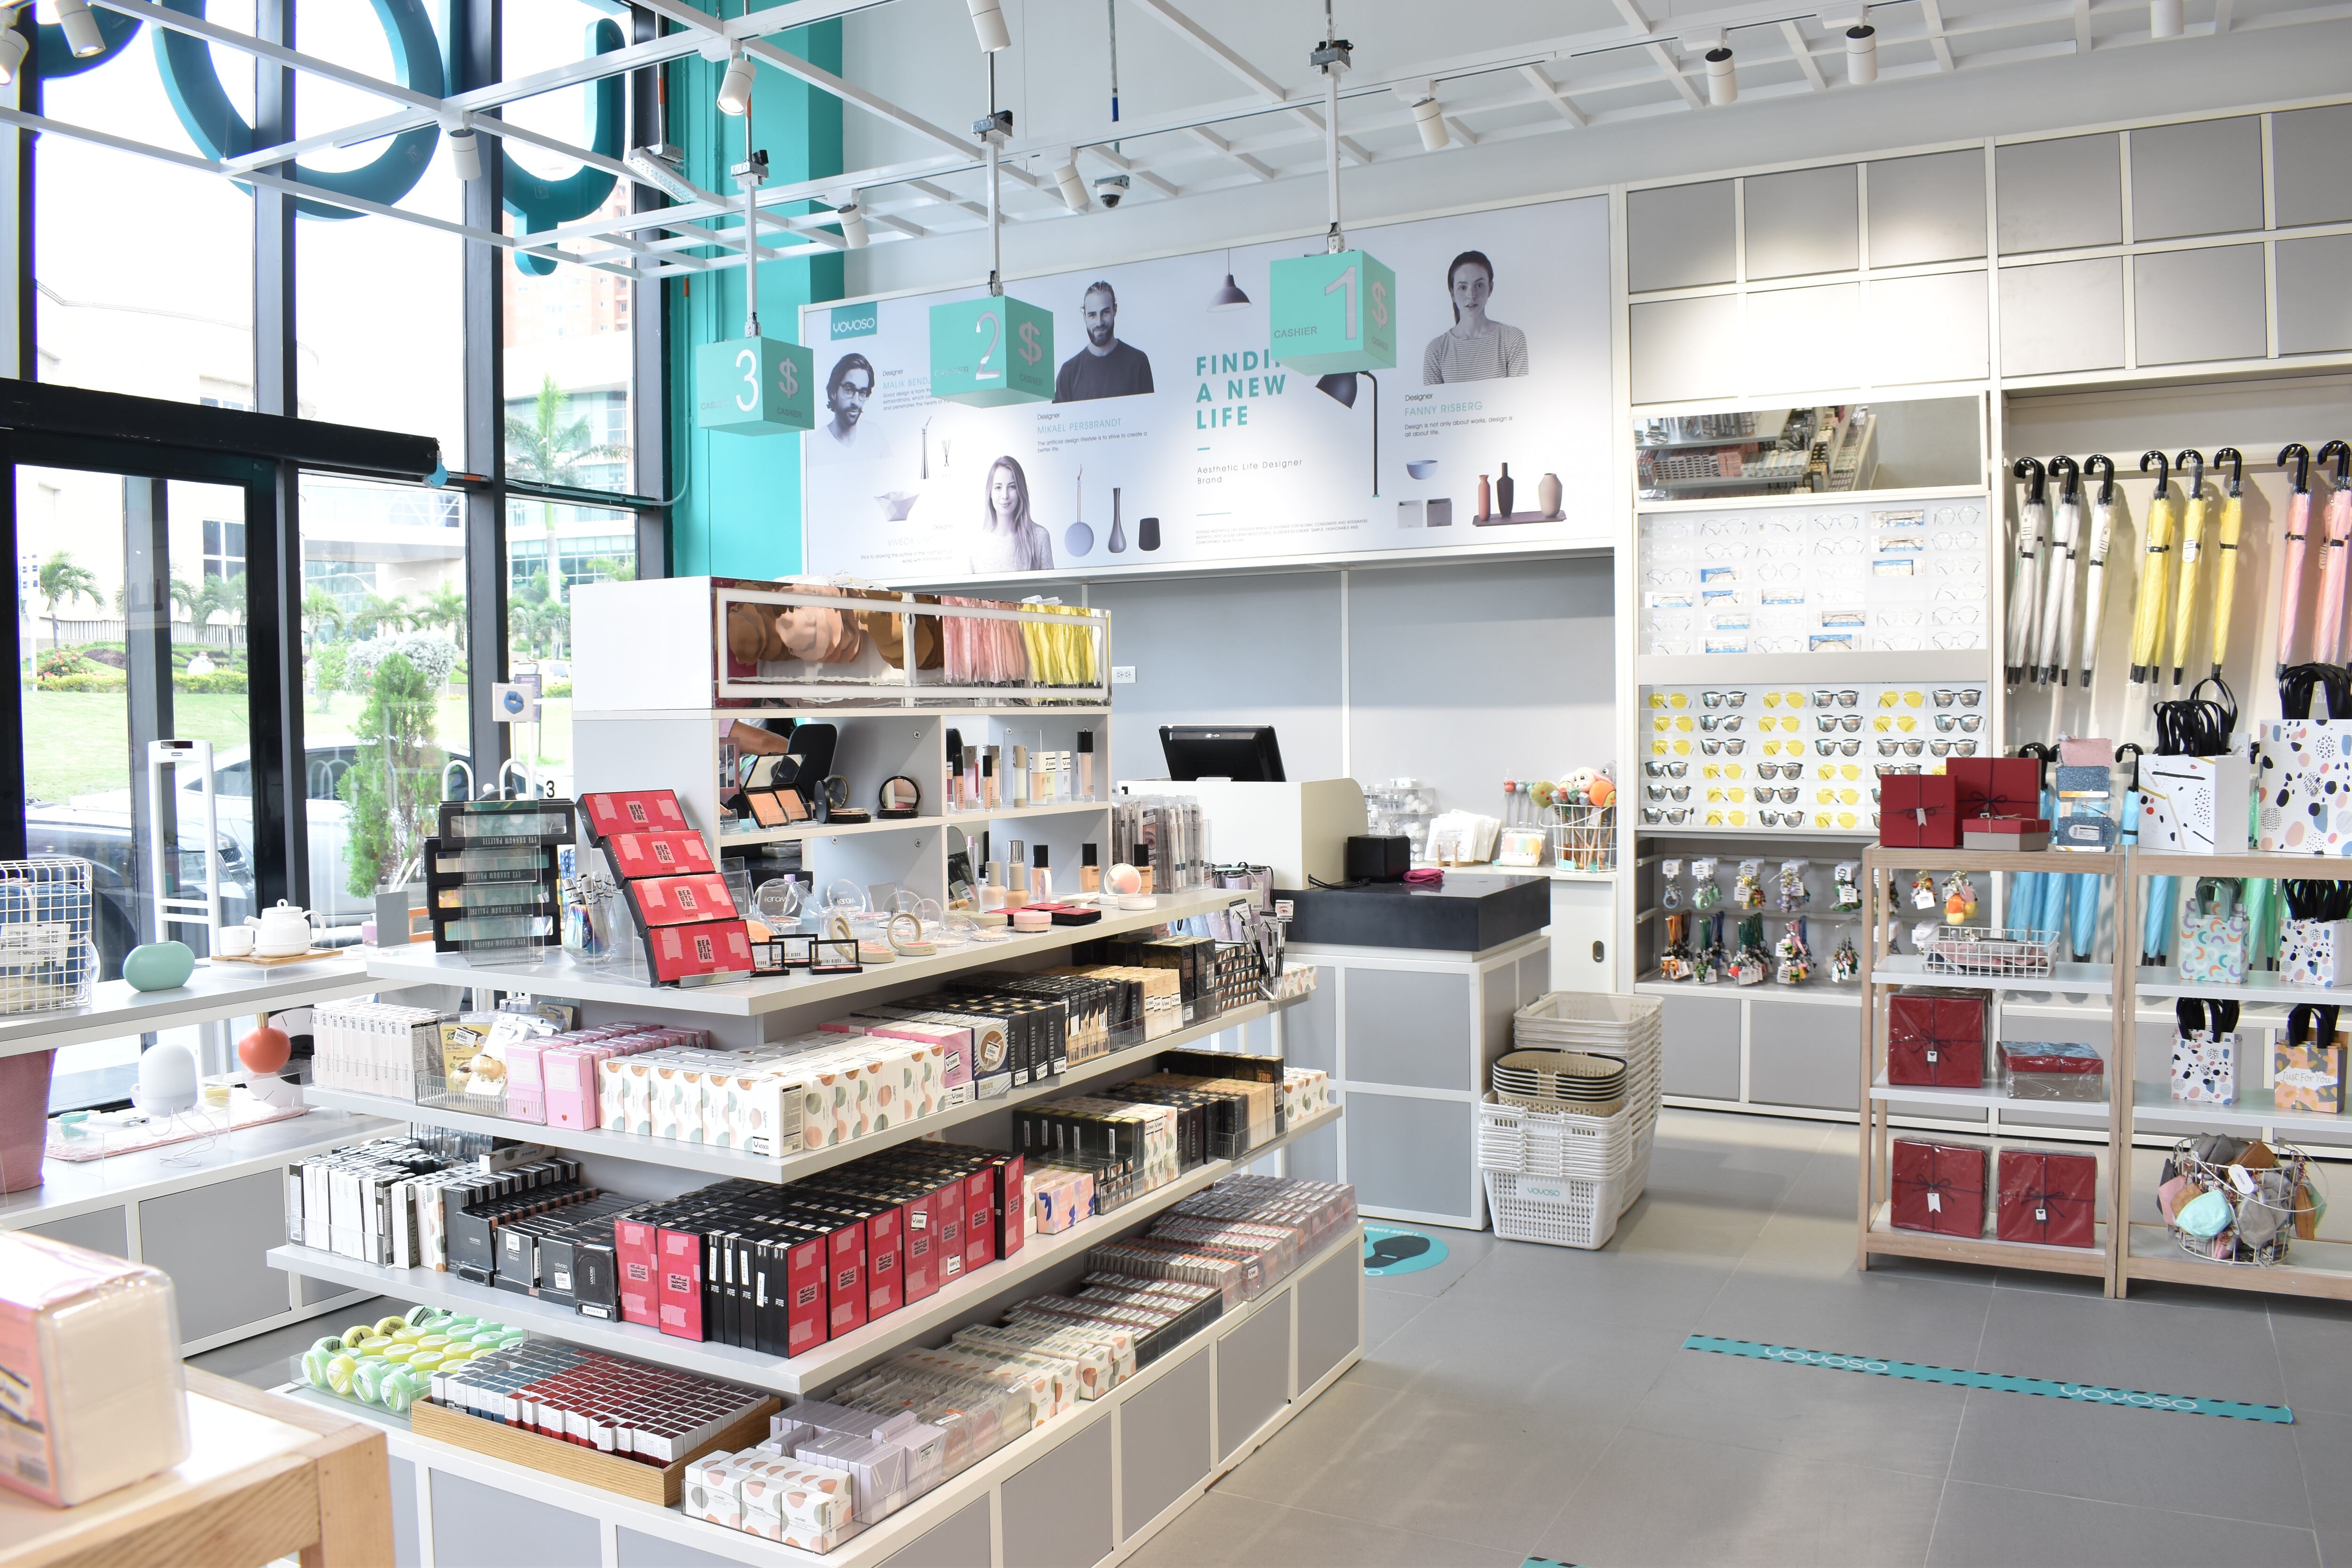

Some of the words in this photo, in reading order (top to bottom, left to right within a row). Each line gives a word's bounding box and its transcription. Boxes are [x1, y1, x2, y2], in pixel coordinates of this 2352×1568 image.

[1325, 265, 1357, 340] 1
[1371, 280, 1389, 330] $
[833, 318, 875, 334] YOYOSO
[1274, 326, 1318, 339] CASHIER
[975, 311, 1001, 381] 2
[1018, 321, 1043, 367] $
[1372, 336, 1389, 352] CASHIER
[736, 349, 759, 412] 3
[779, 358, 799, 399] $
[883, 380, 905, 390] MALIK
[908, 377, 931, 387] BEND
[1019, 374, 1043, 387] CASHIER
[1196, 382, 1213, 403] A
[1227, 374, 1287, 400] NEW
[1405, 393, 1433, 402] Designer
[777, 407, 803, 419] CASHIER
[1405, 406, 1437, 417] FANNY
[1441, 401, 1483, 414] RISBERG
[1197, 405, 1248, 430] LIFE
[1037, 424, 1066, 434] MIKAEL
[1069, 418, 1122, 431] PERSBRANDT
[1197, 464, 1239, 474] Aesthetic
[1263, 459, 1303, 469] Designer
[1197, 476, 1223, 485] Brand
[887, 537, 914, 546] VIVECA
[546, 780, 555, 798] 3
[2280, 1071, 2298, 1082] Just
[2301, 1074, 2315, 1083] For
[2315, 1075, 2332, 1084] You
[980, 1082, 994, 1091] CREATE
[1528, 1187, 1560, 1197] YOYOSO
[1764, 1347, 1889, 1371] YOYOSO
[2061, 1385, 2198, 1410] YOYOSO
